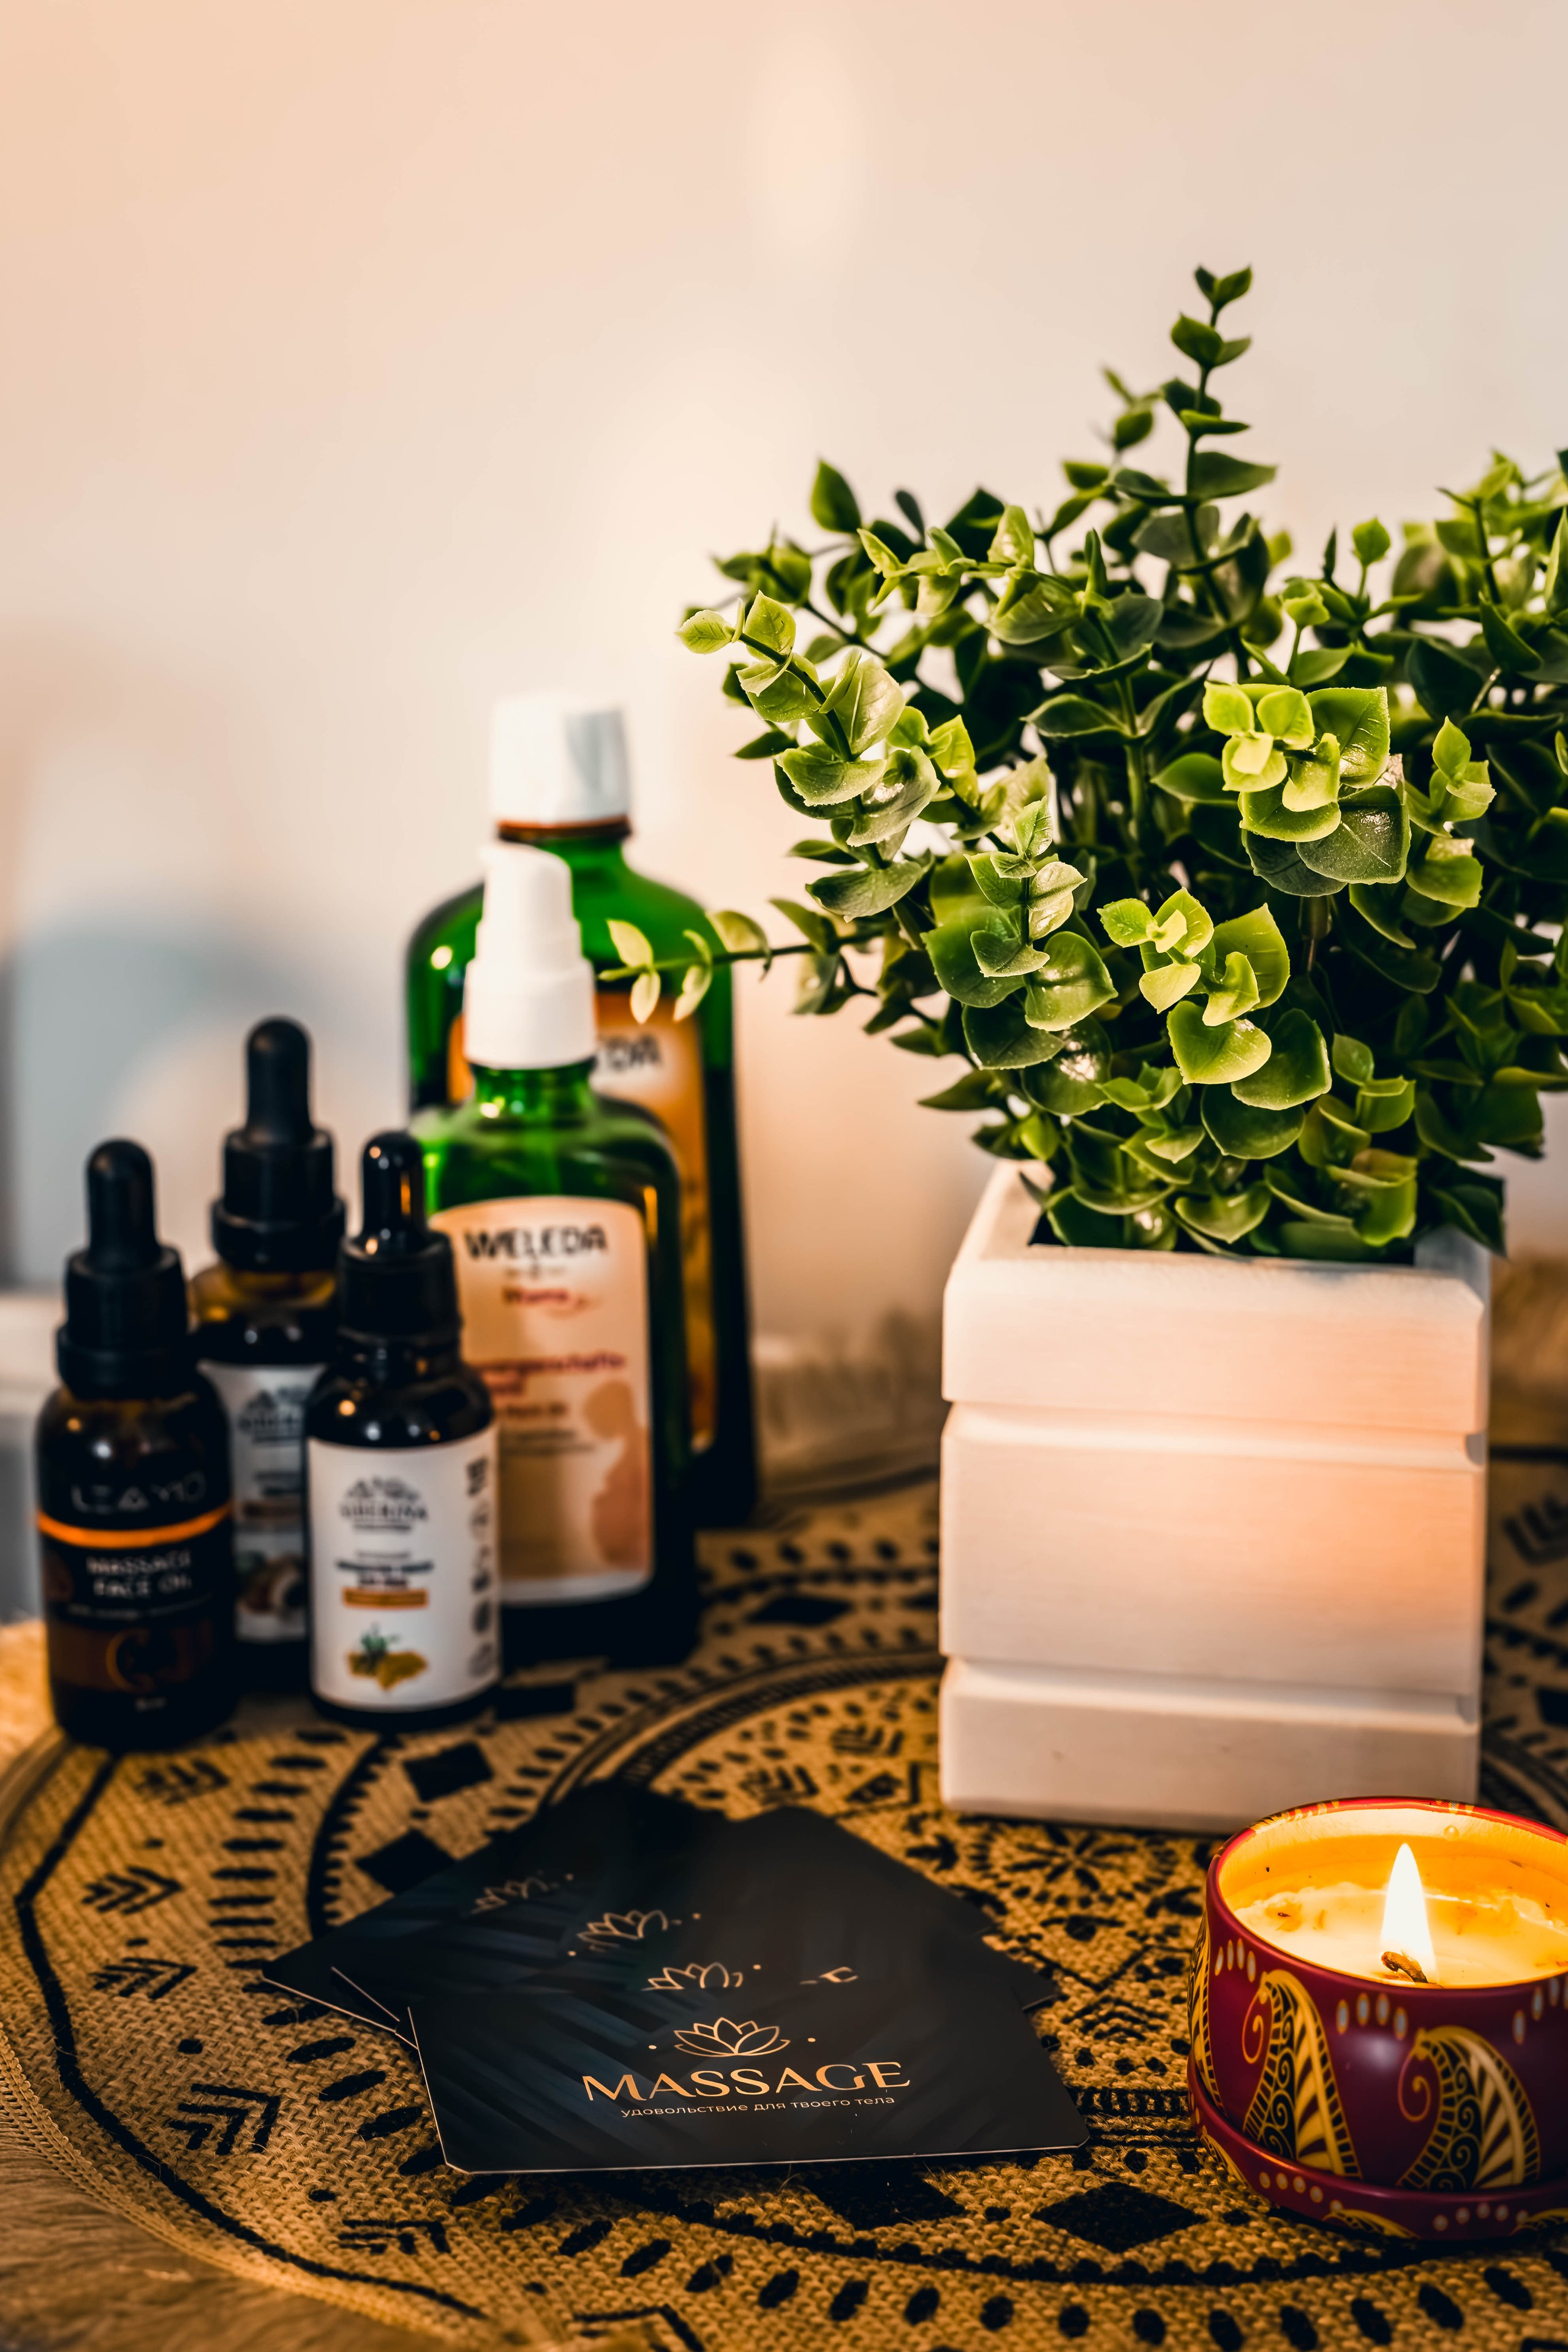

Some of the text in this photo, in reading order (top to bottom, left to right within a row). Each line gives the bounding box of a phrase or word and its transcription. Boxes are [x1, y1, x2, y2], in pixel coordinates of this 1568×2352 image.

[464, 1223, 608, 1259] WELEDA
[581, 2062, 911, 2101] MASSAGE
[620, 2095, 895, 2118] удовольствие для твоего тела
